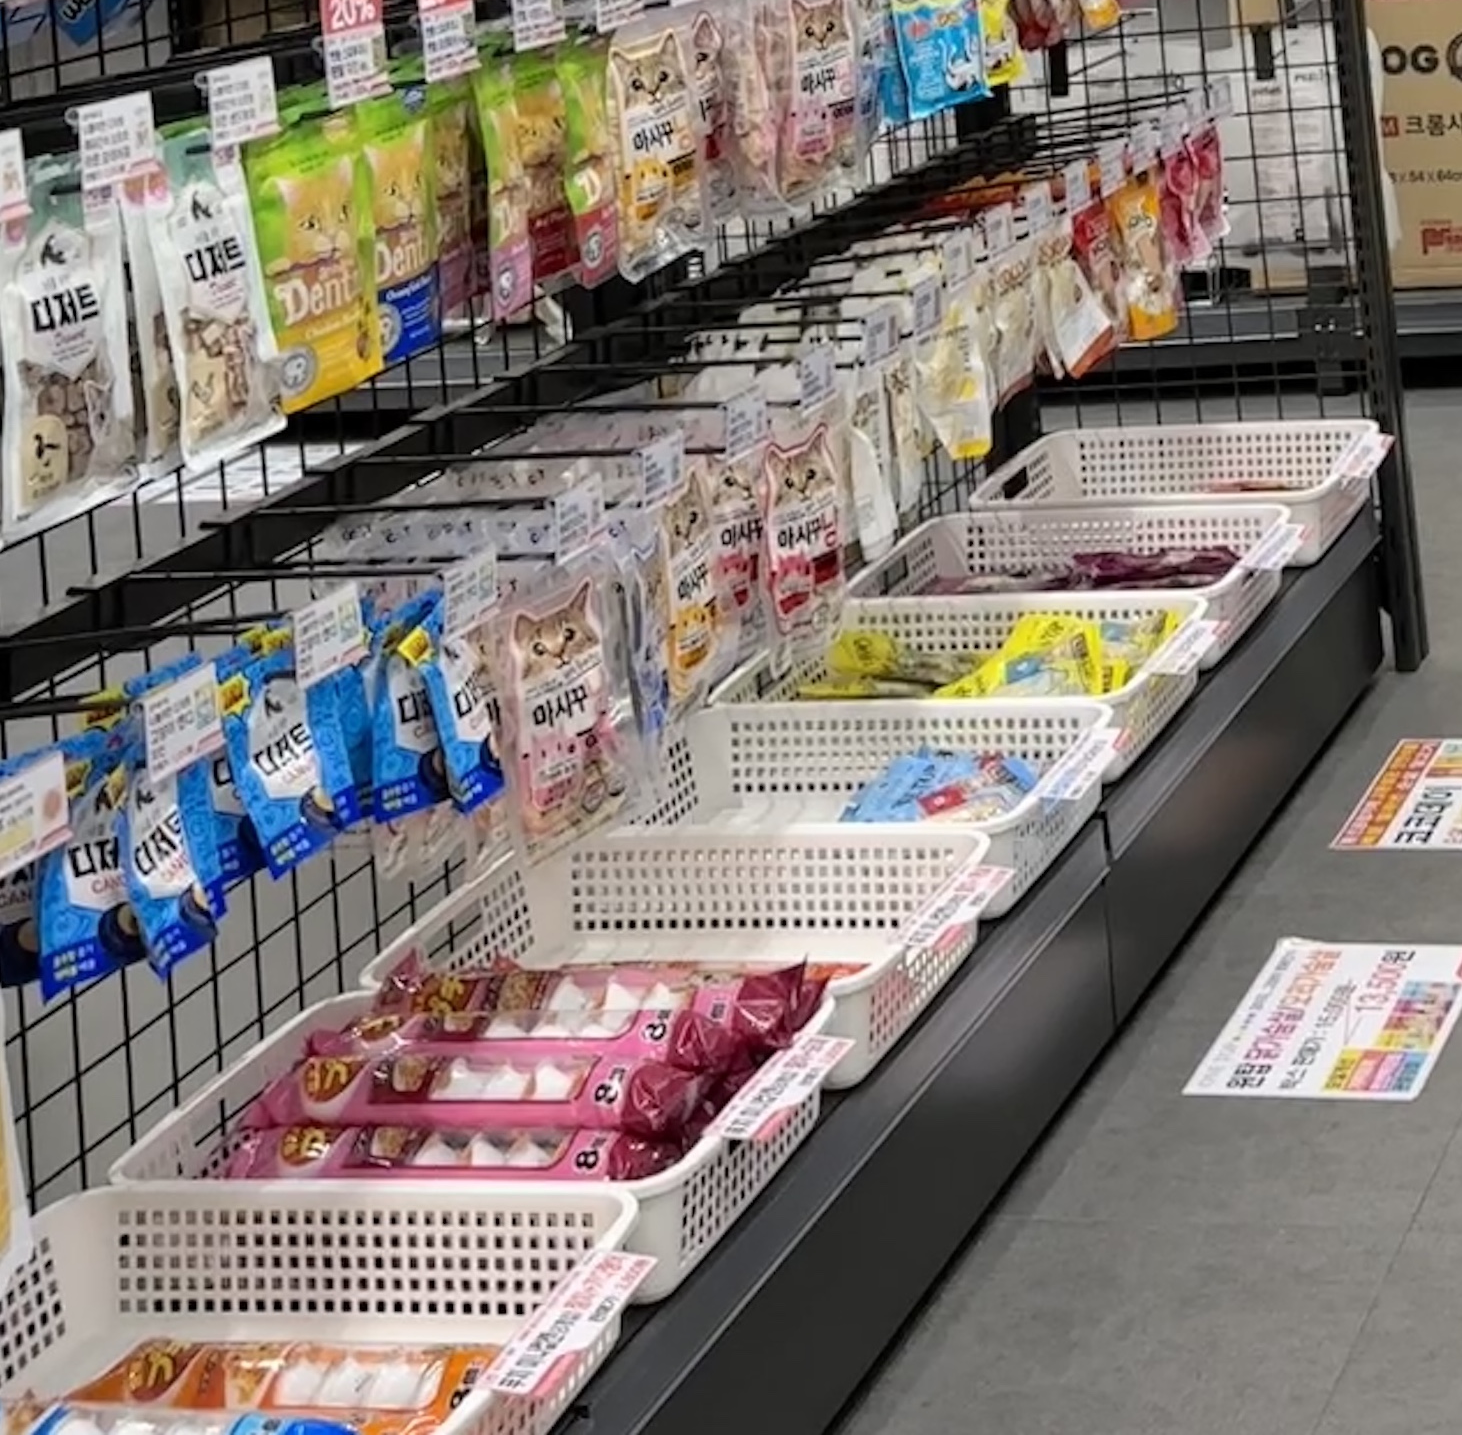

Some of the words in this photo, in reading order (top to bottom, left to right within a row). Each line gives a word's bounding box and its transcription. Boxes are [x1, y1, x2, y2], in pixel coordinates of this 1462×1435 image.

[1382, 44, 1440, 76] OG
[184, 237, 246, 283] 디저트
[30, 283, 100, 333] 디저트
